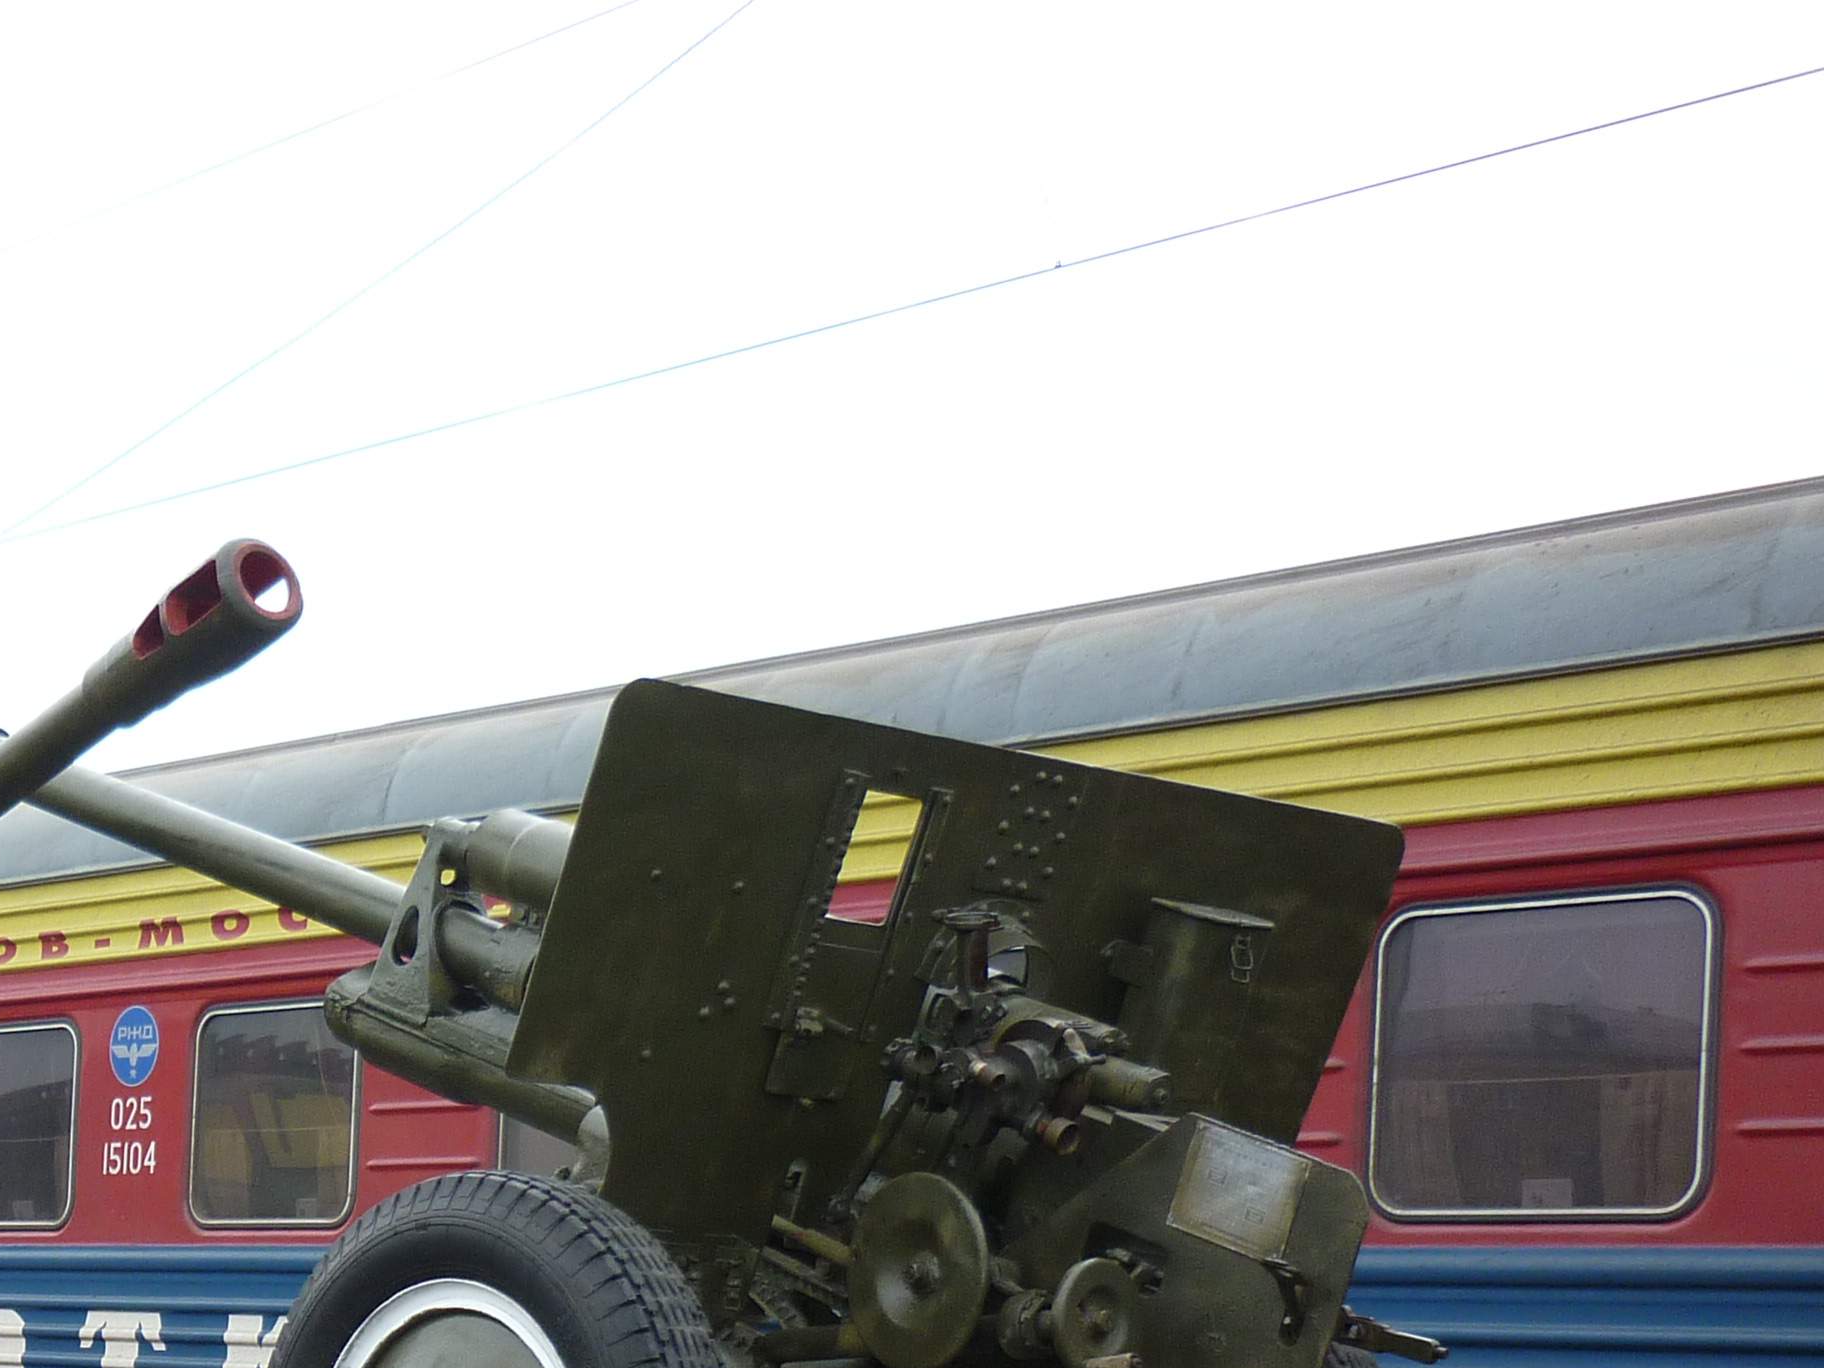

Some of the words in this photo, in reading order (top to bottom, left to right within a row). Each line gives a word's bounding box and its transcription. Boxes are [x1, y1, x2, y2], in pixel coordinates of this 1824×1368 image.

[117, 1024, 153, 1041] РЖД
[110, 1096, 153, 1131] 025
[102, 1141, 157, 1176] 15104
